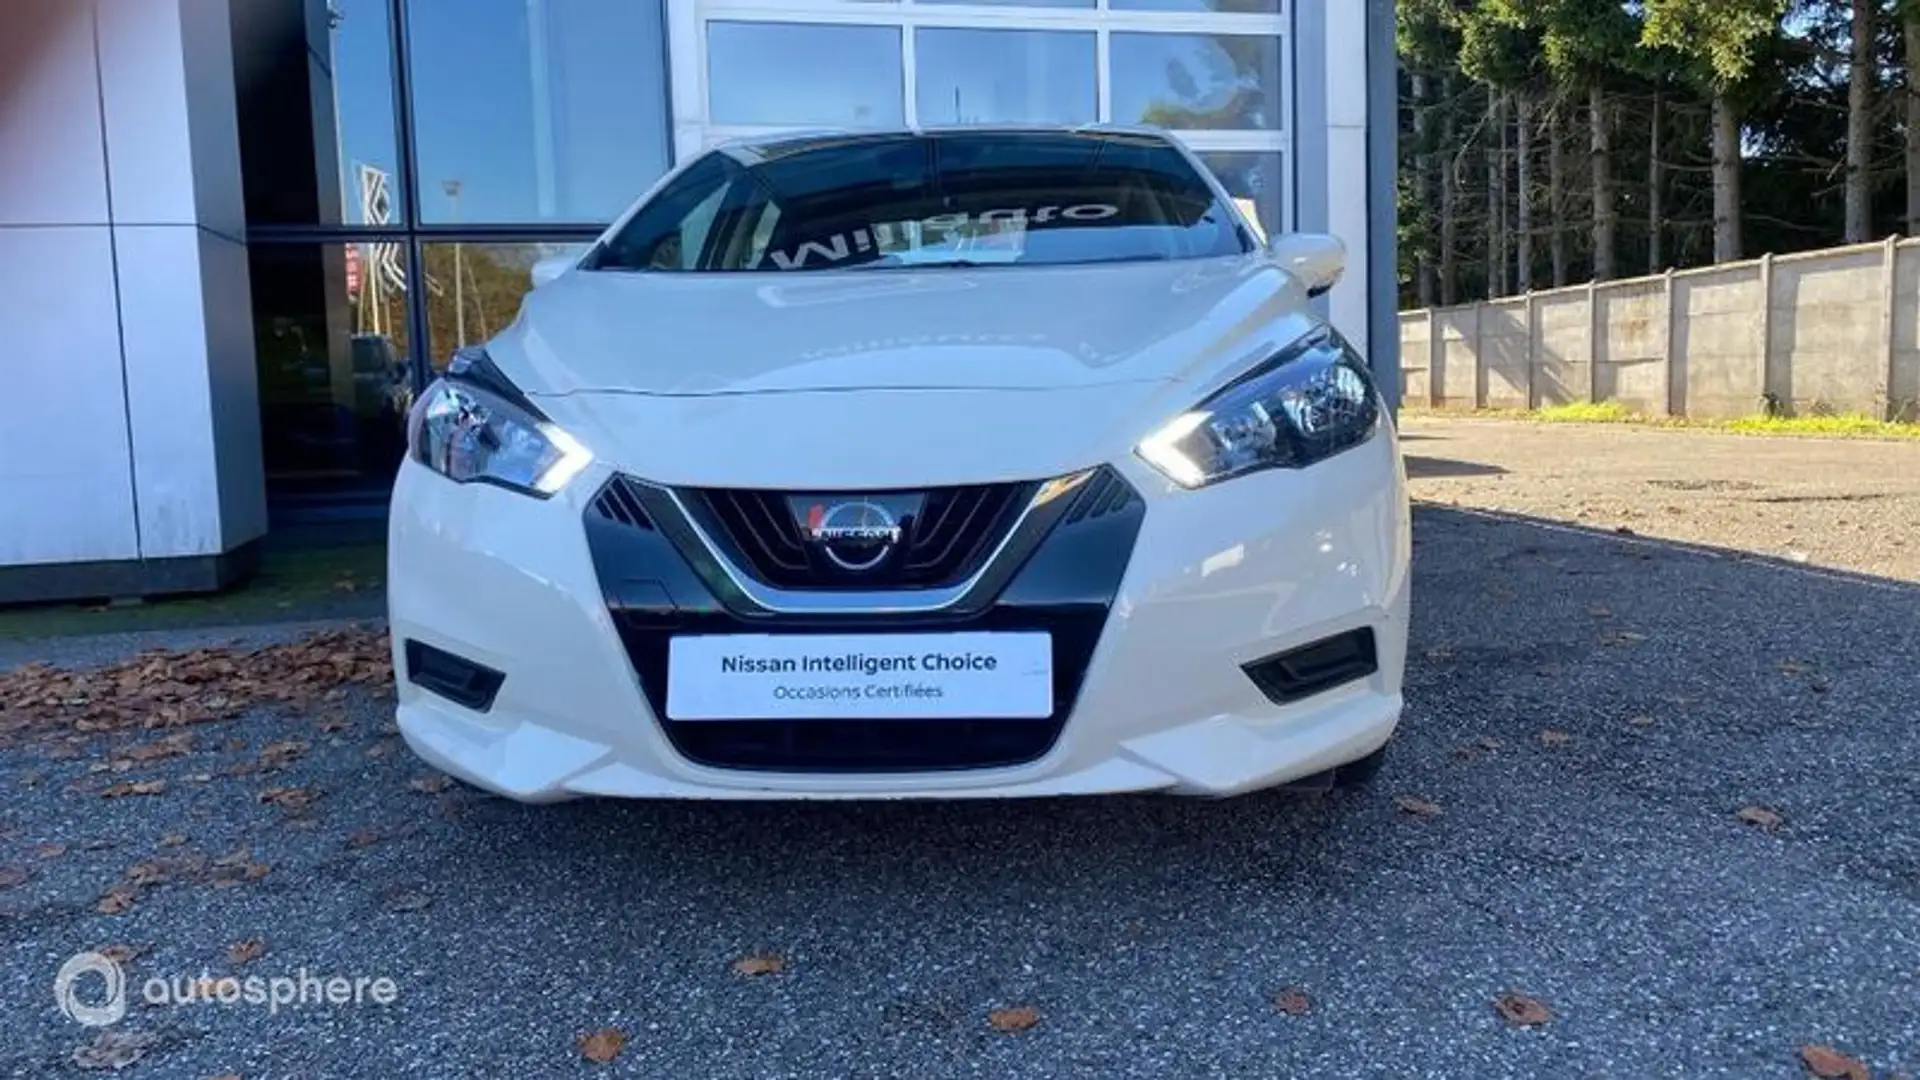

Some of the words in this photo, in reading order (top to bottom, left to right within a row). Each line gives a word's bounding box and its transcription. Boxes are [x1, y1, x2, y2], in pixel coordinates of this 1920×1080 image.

[721, 655, 796, 673] Nissan
[802, 654, 916, 675] Intelligent
[921, 653, 997, 671] Choice
[773, 685, 860, 700] Occasions
[864, 682, 942, 699] Certifiées
